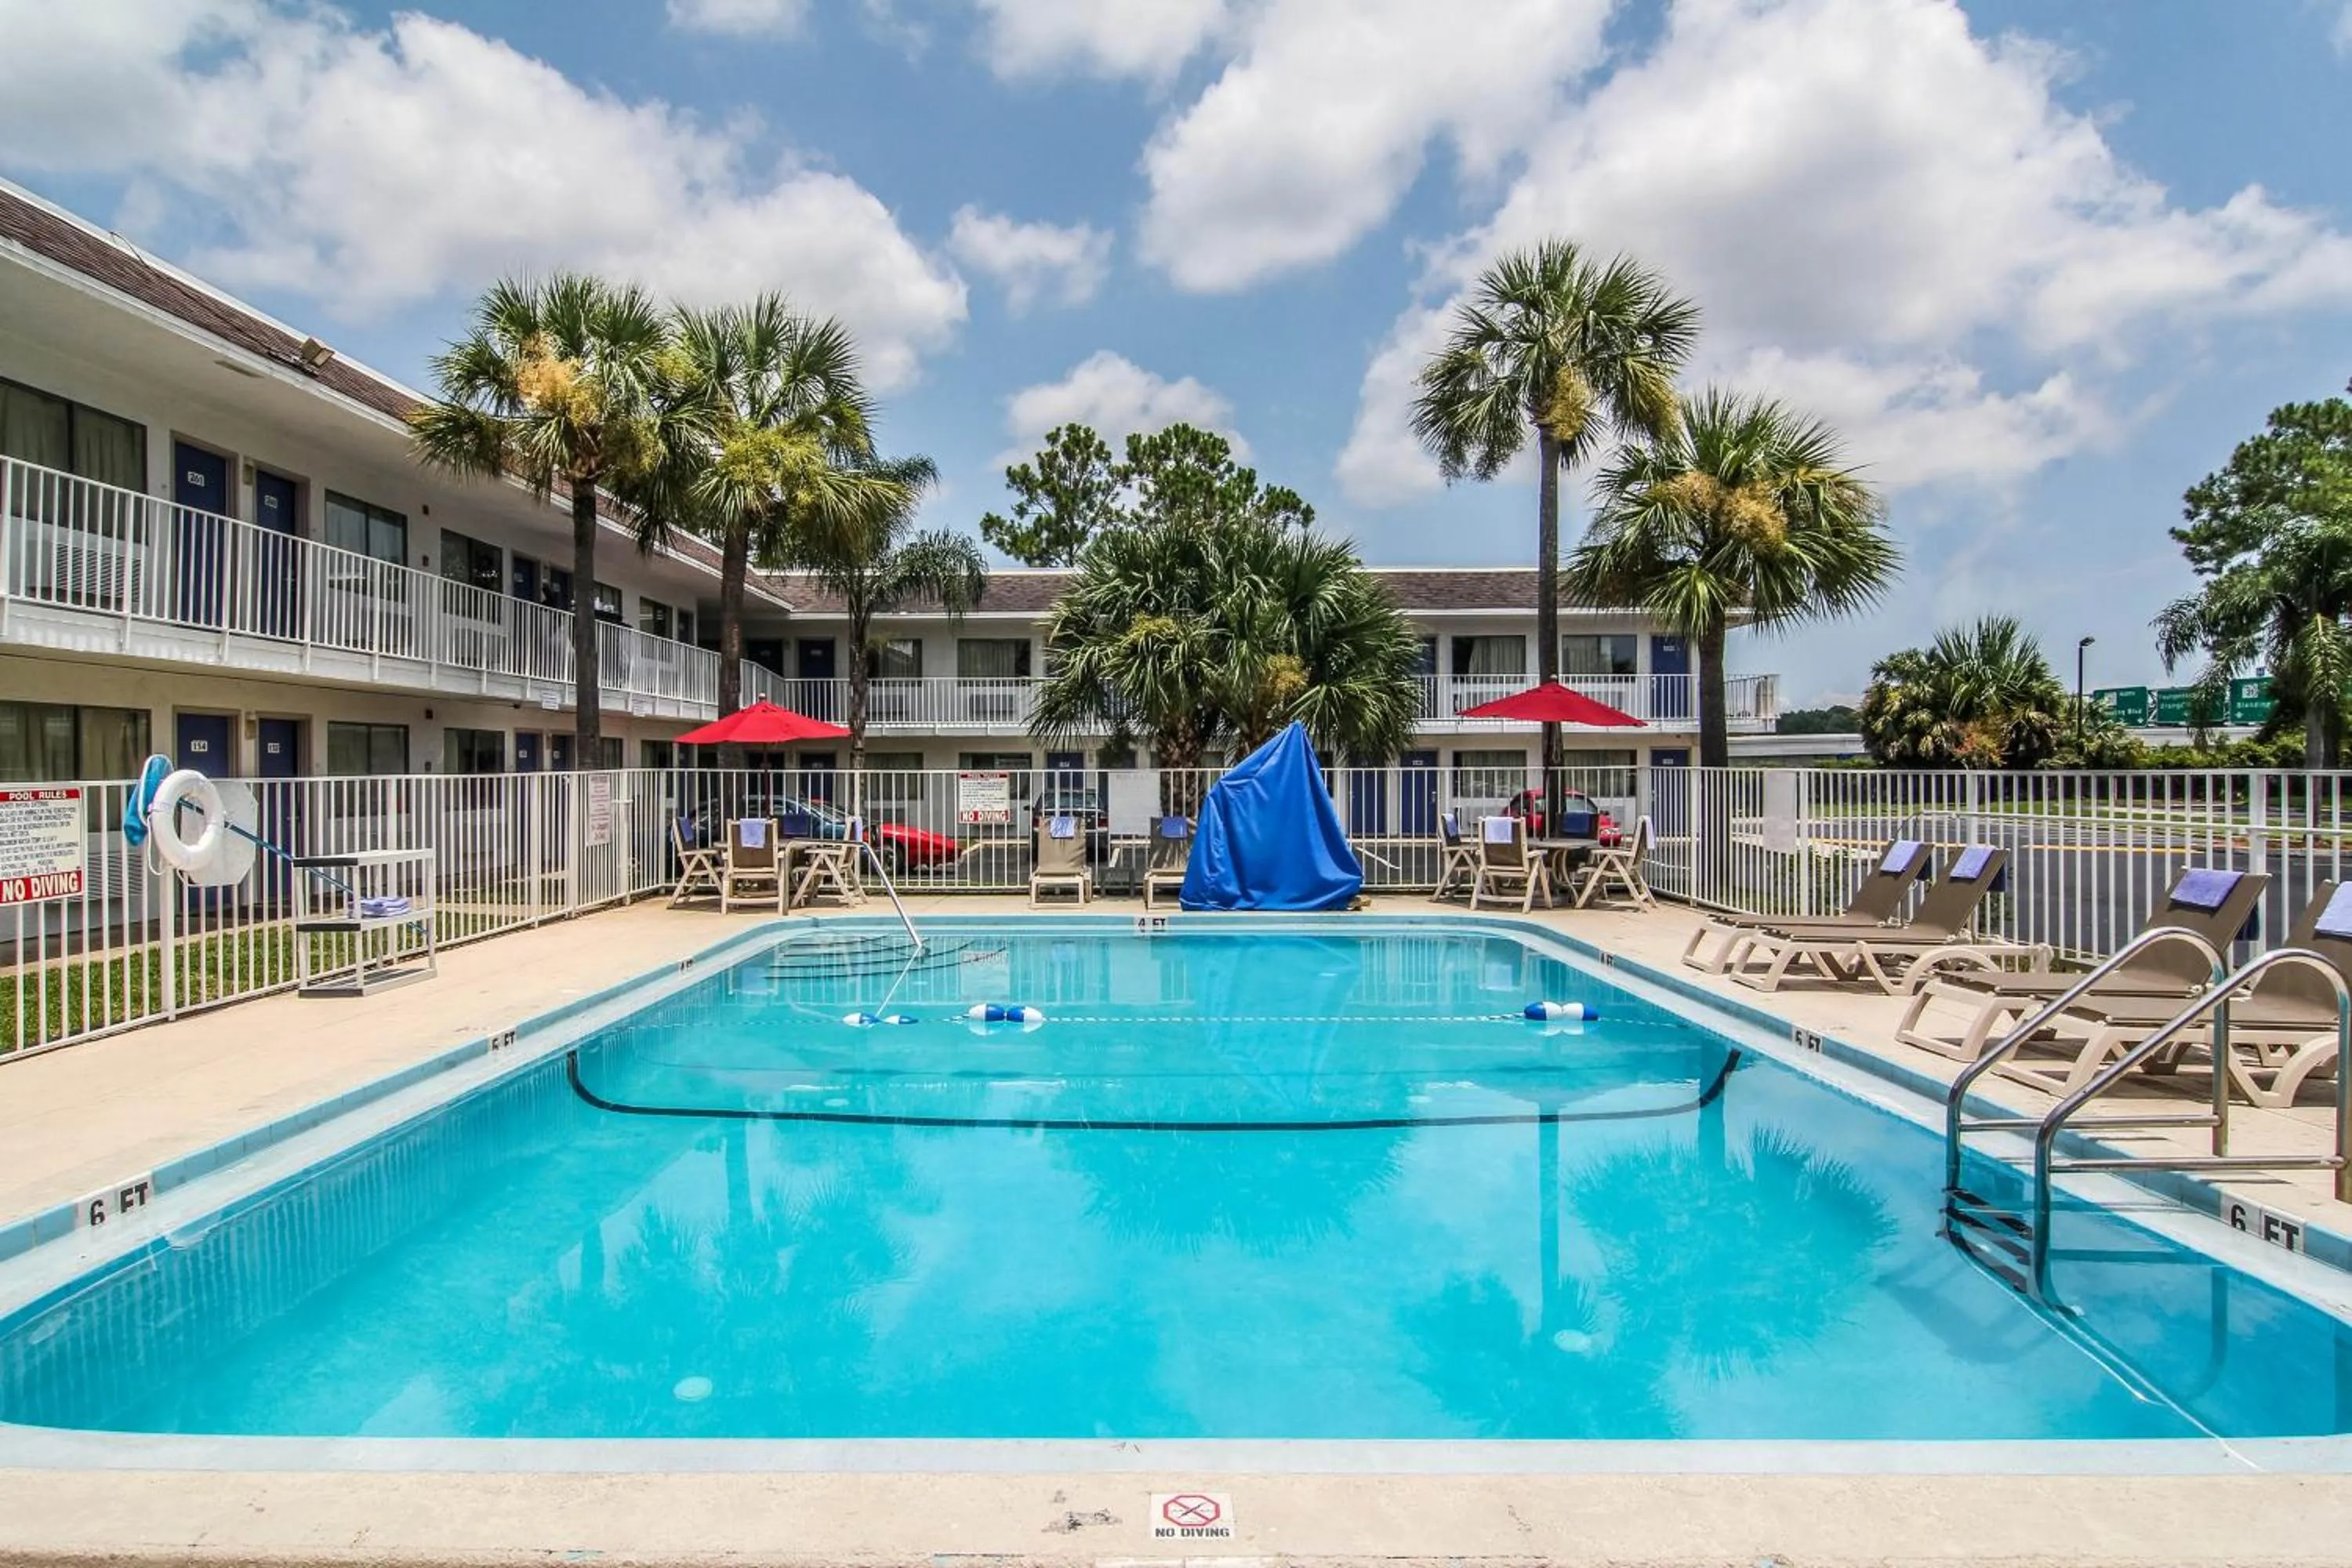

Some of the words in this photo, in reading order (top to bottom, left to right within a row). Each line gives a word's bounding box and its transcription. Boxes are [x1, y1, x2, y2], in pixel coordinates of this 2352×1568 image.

[9, 792, 34, 800] POOL
[38, 790, 67, 799] RULES
[962, 811, 975, 822] NO
[2, 879, 25, 902] NO
[31, 873, 78, 897] DIVING
[90, 1200, 105, 1227] 6
[120, 1181, 148, 1214] FT
[2230, 1203, 2246, 1232] 6
[2263, 1214, 2299, 1250] FT
[1155, 1527, 1175, 1537] NO
[1181, 1527, 1230, 1537] DIVING
